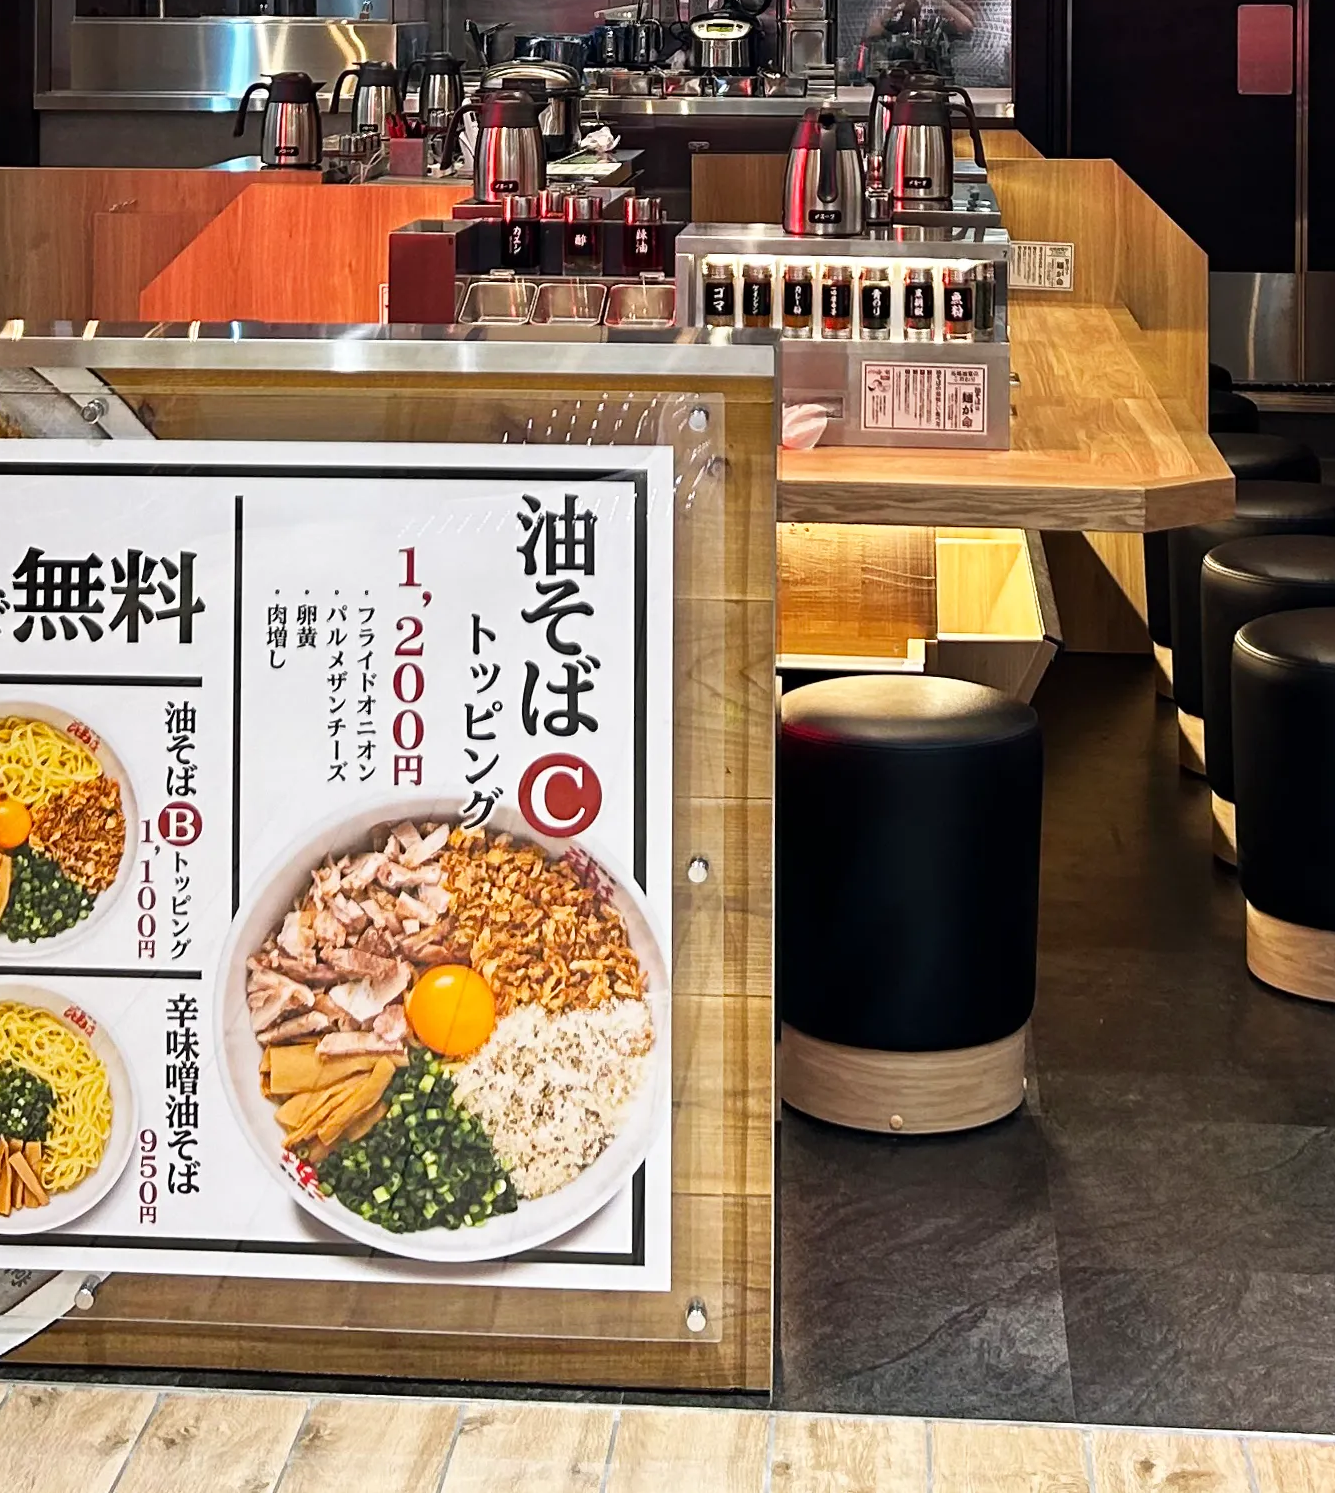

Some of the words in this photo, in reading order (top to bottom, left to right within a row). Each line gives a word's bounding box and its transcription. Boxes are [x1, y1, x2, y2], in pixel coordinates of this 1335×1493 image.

[712, 286, 726, 312] ゴマ
[392, 546, 433, 787] 1,200円
[463, 612, 504, 831] トッピング
[137, 819, 162, 960] 1,100円
[138, 1129, 158, 1225] 950円
[165, 992, 201, 1195] 辛味噌油そば
